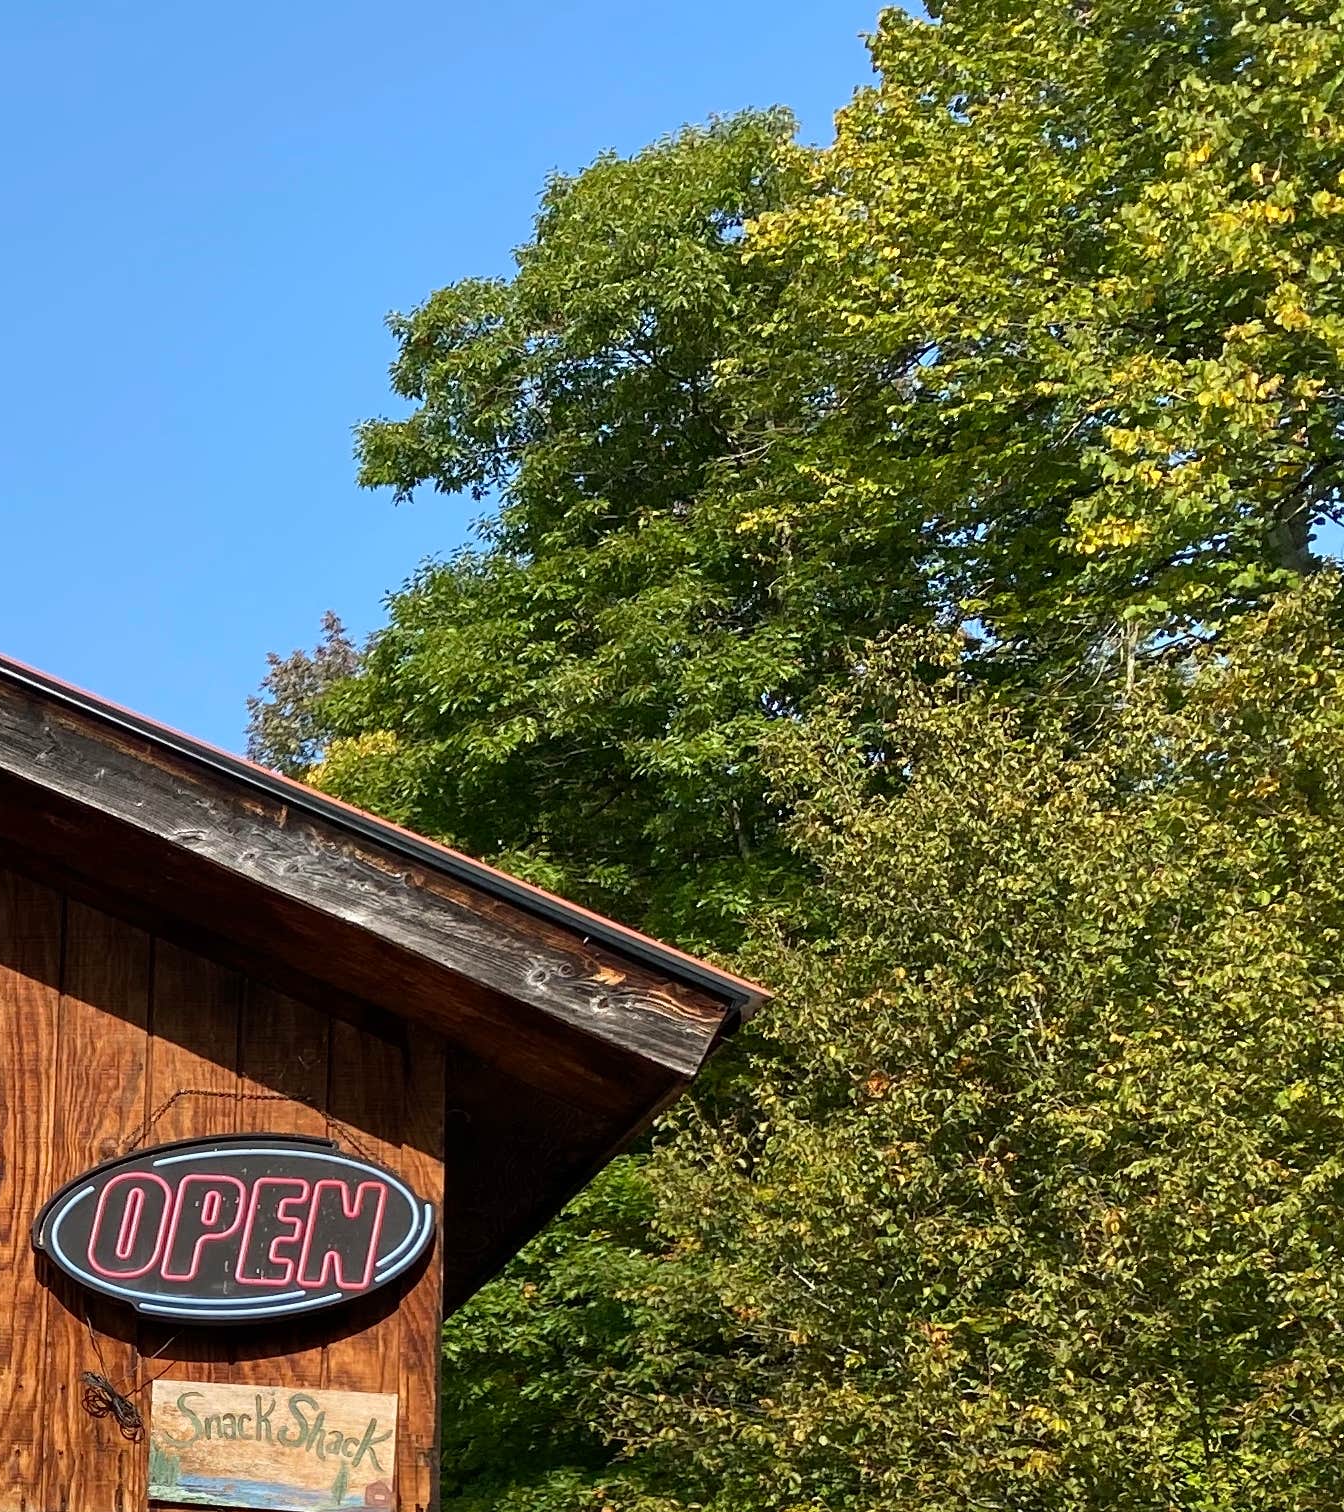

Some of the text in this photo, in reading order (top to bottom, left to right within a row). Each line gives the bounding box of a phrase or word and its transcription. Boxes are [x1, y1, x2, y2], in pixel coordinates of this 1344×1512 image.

[87, 1171, 388, 1290] OPEN
[164, 1391, 393, 1472] Snack Shack
